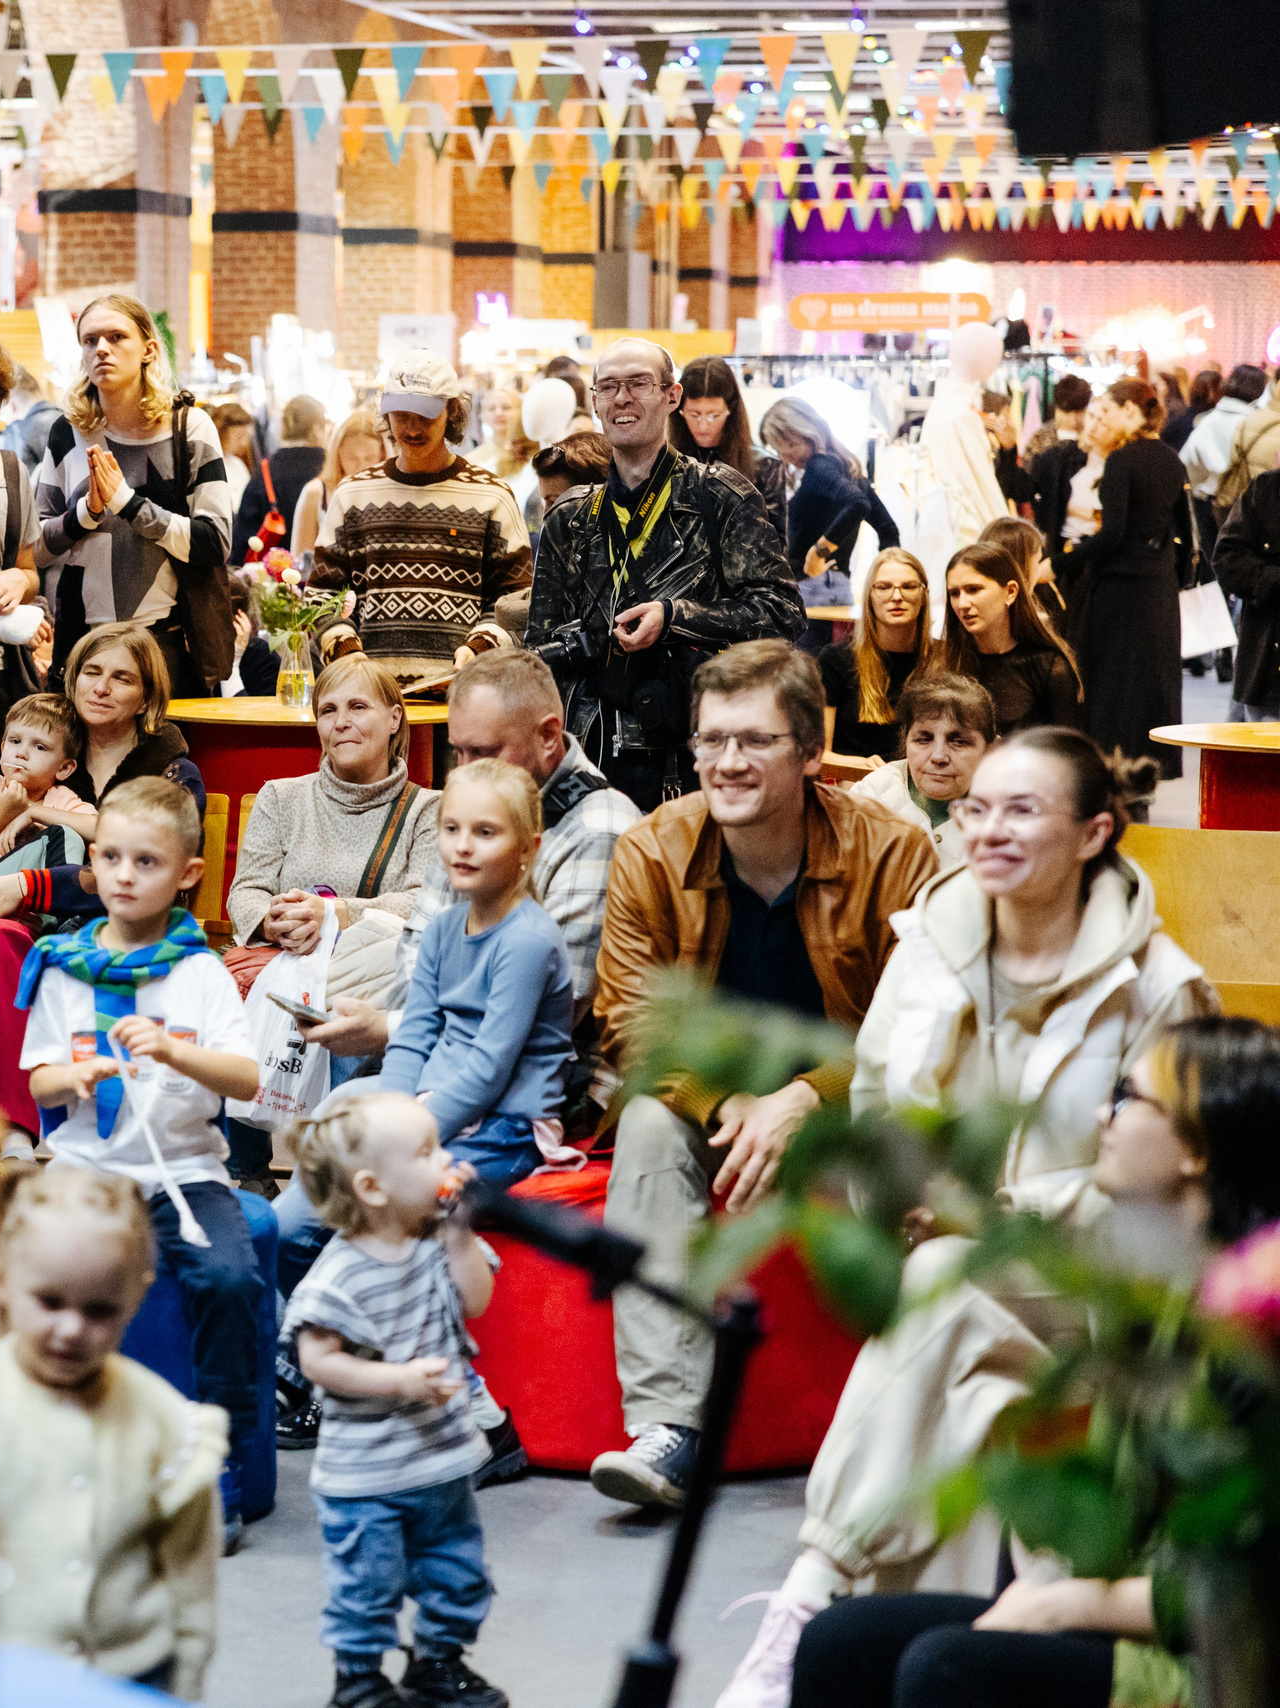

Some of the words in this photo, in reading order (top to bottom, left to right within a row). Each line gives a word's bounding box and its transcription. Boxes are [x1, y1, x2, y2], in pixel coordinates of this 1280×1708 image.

[831, 303, 855, 317] no
[857, 298, 918, 317] drama
[591, 490, 604, 516] Nikon
[638, 492, 656, 518] Nikon
